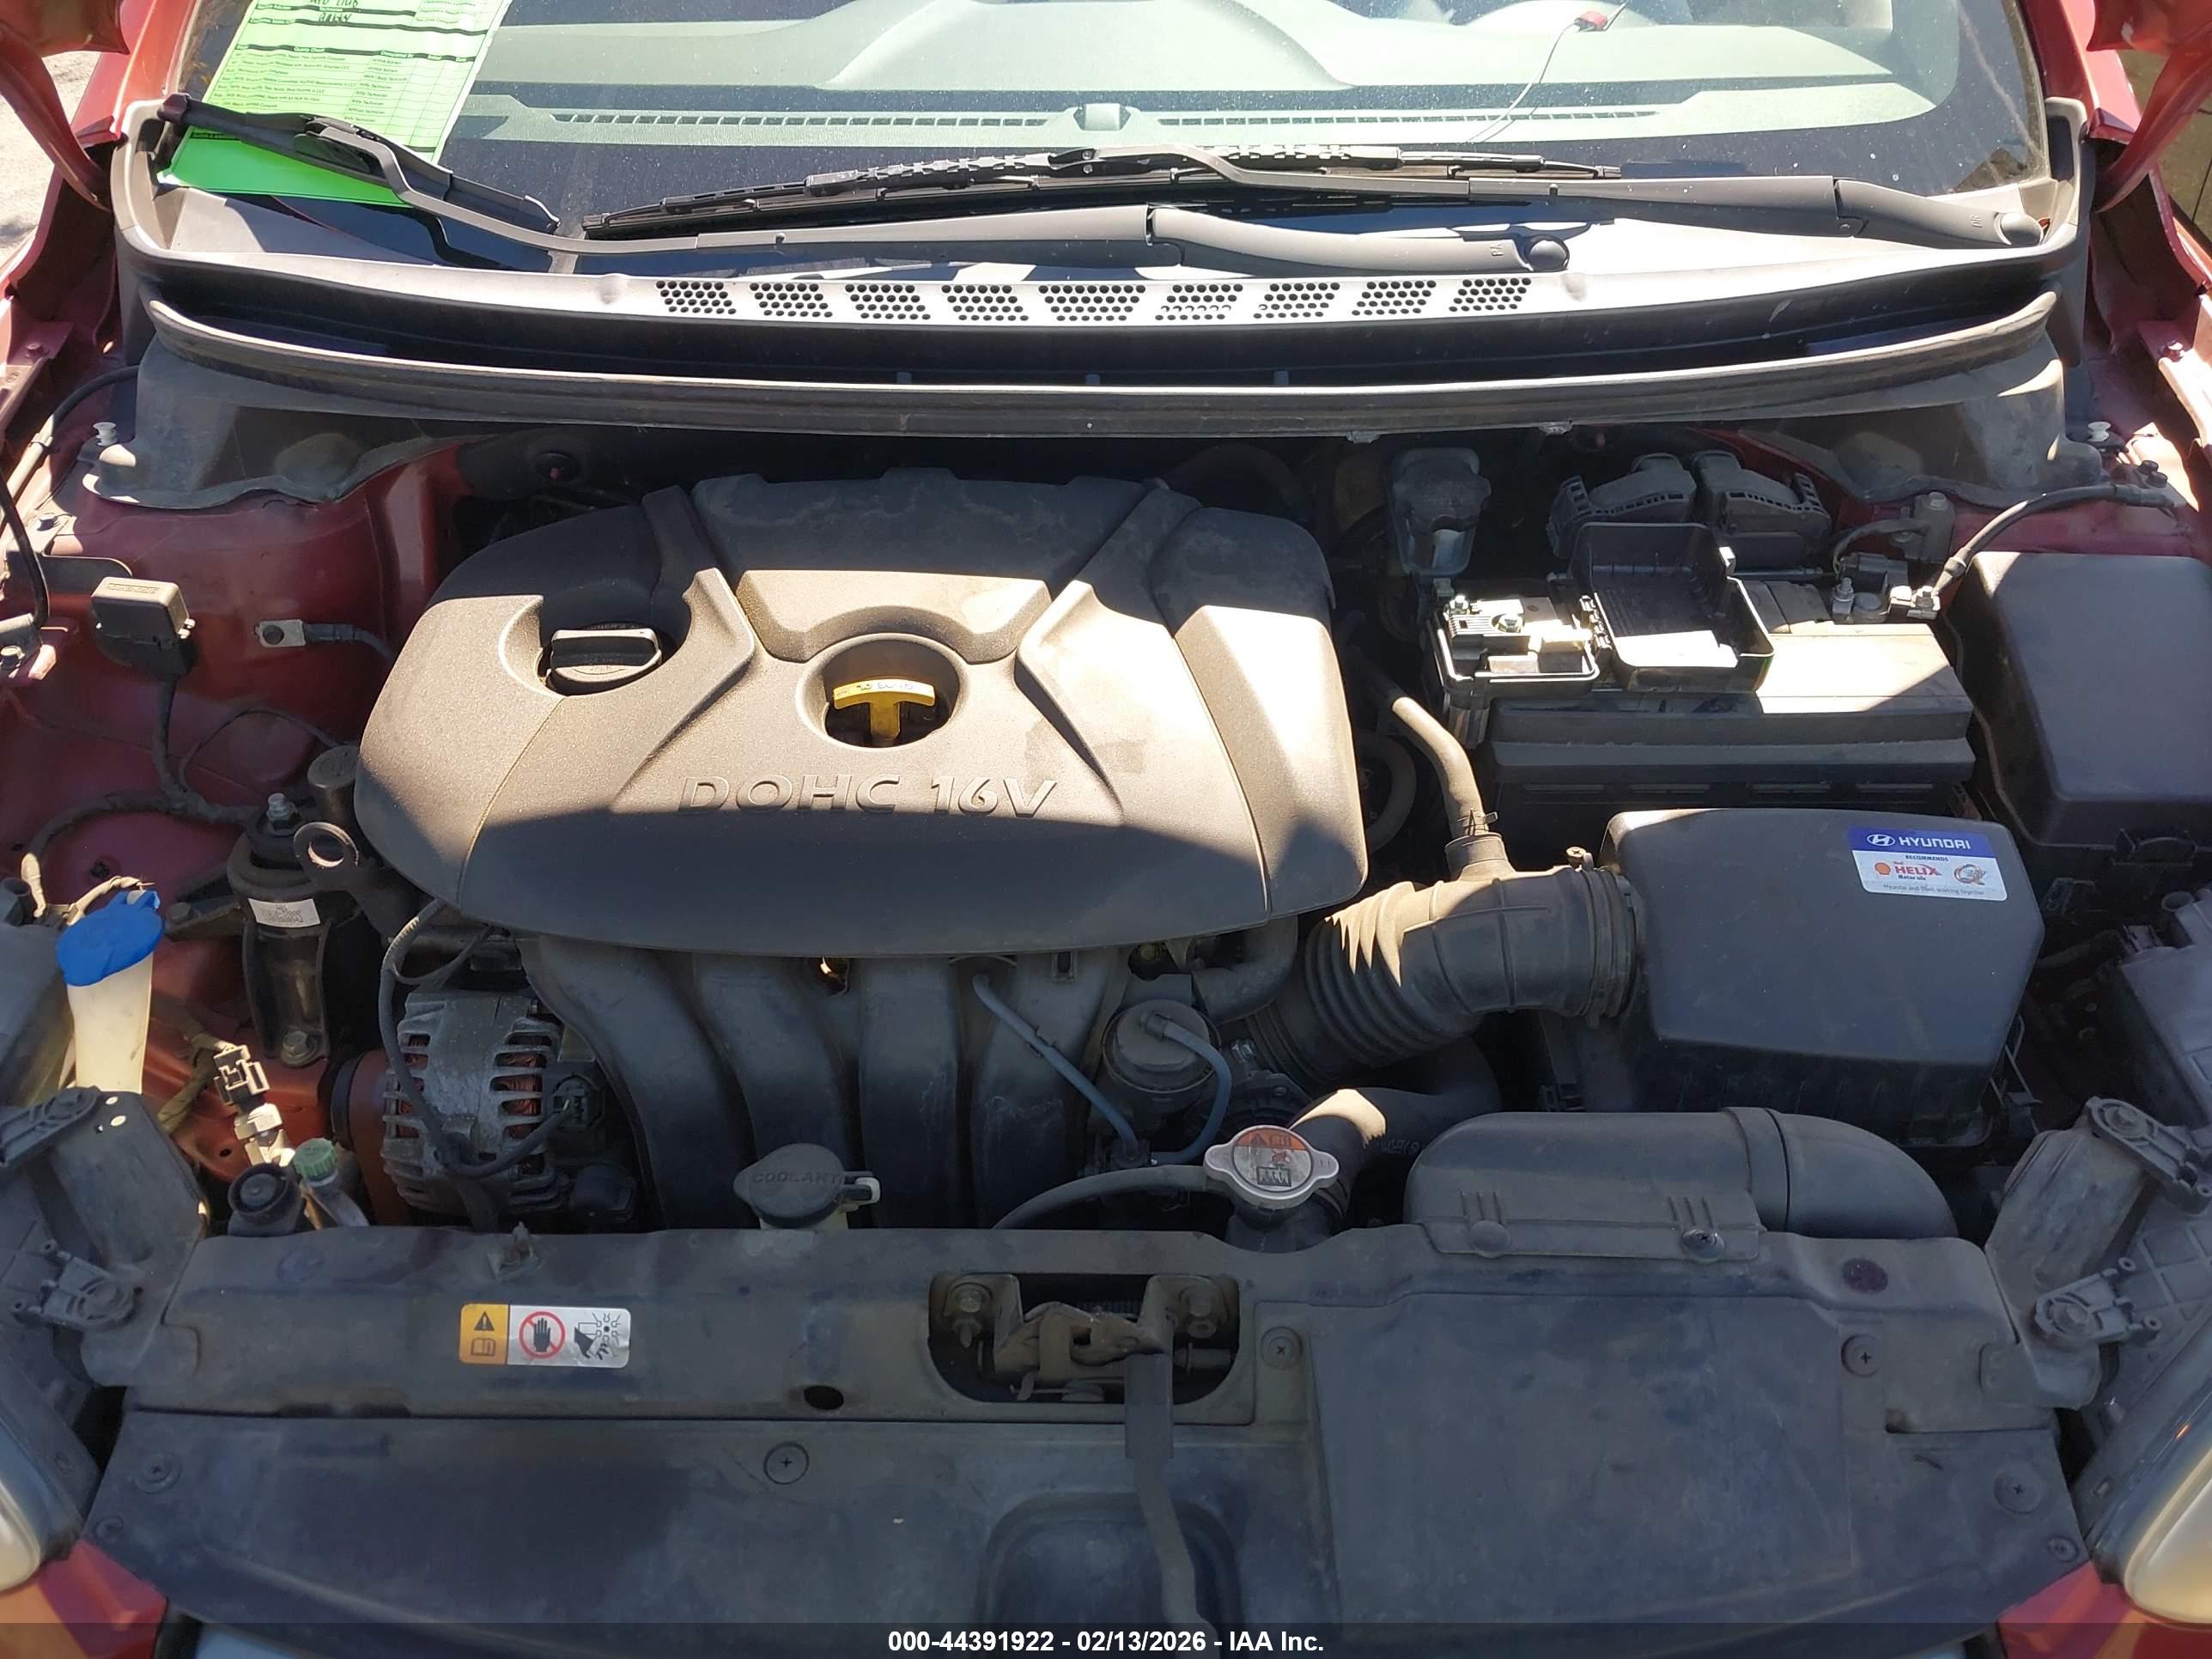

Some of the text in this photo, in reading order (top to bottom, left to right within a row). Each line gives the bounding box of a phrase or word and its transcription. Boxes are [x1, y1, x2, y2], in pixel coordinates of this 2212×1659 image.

[678, 774, 1058, 819] DOHC 16V
[1898, 836, 1972, 850] HYUNDAI
[1894, 864, 1942, 876] HELIX
[753, 1170, 841, 1185] COOLANT
